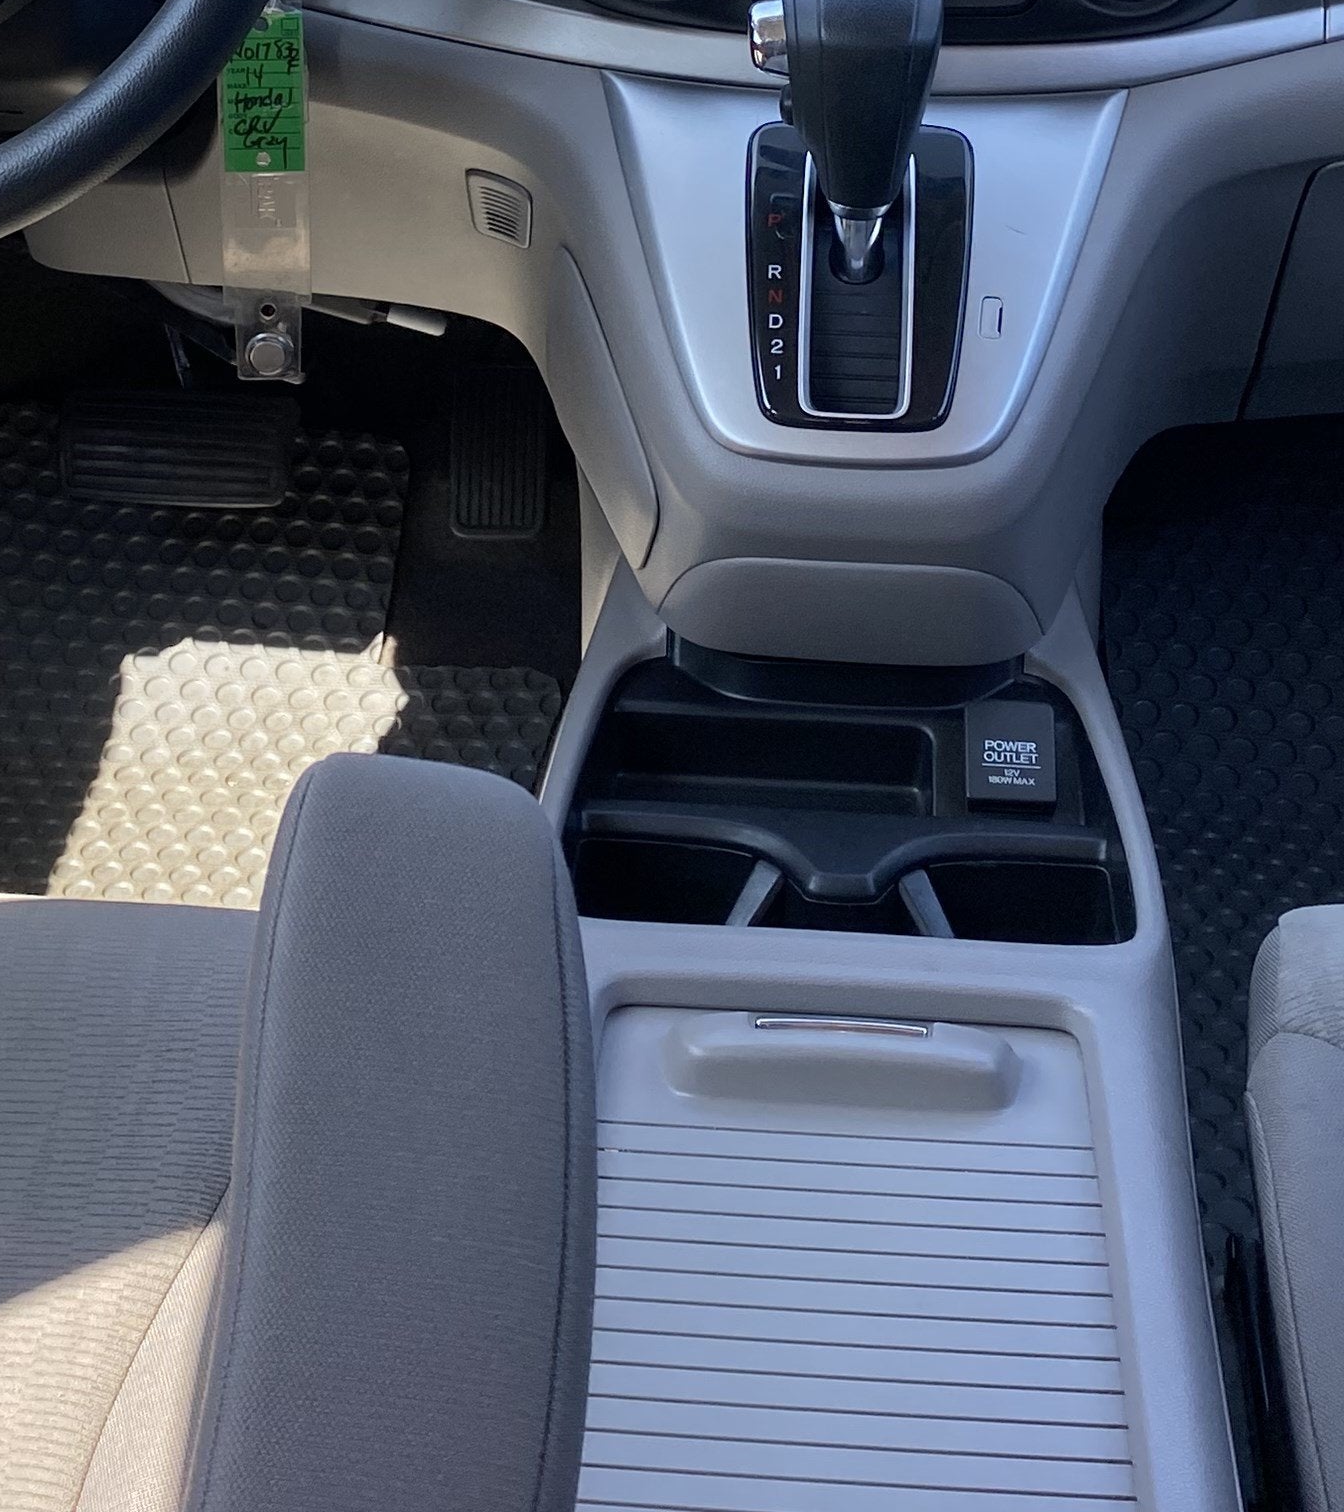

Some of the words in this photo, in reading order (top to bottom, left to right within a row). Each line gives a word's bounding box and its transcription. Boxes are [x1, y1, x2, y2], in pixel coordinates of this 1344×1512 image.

[246, 63, 263, 88] 14
[234, 87, 283, 113] Honda
[234, 108, 282, 136] CRV
[767, 213, 782, 227] P
[768, 264, 782, 279] R
[768, 289, 783, 303] N
[768, 314, 784, 329] D
[770, 339, 784, 354] 2
[774, 364, 782, 380] 1
[984, 739, 1037, 753] POWER
[983, 751, 1039, 764] OUTLET
[1004, 769, 1020, 777] 12V
[1013, 777, 1036, 786] MAX
